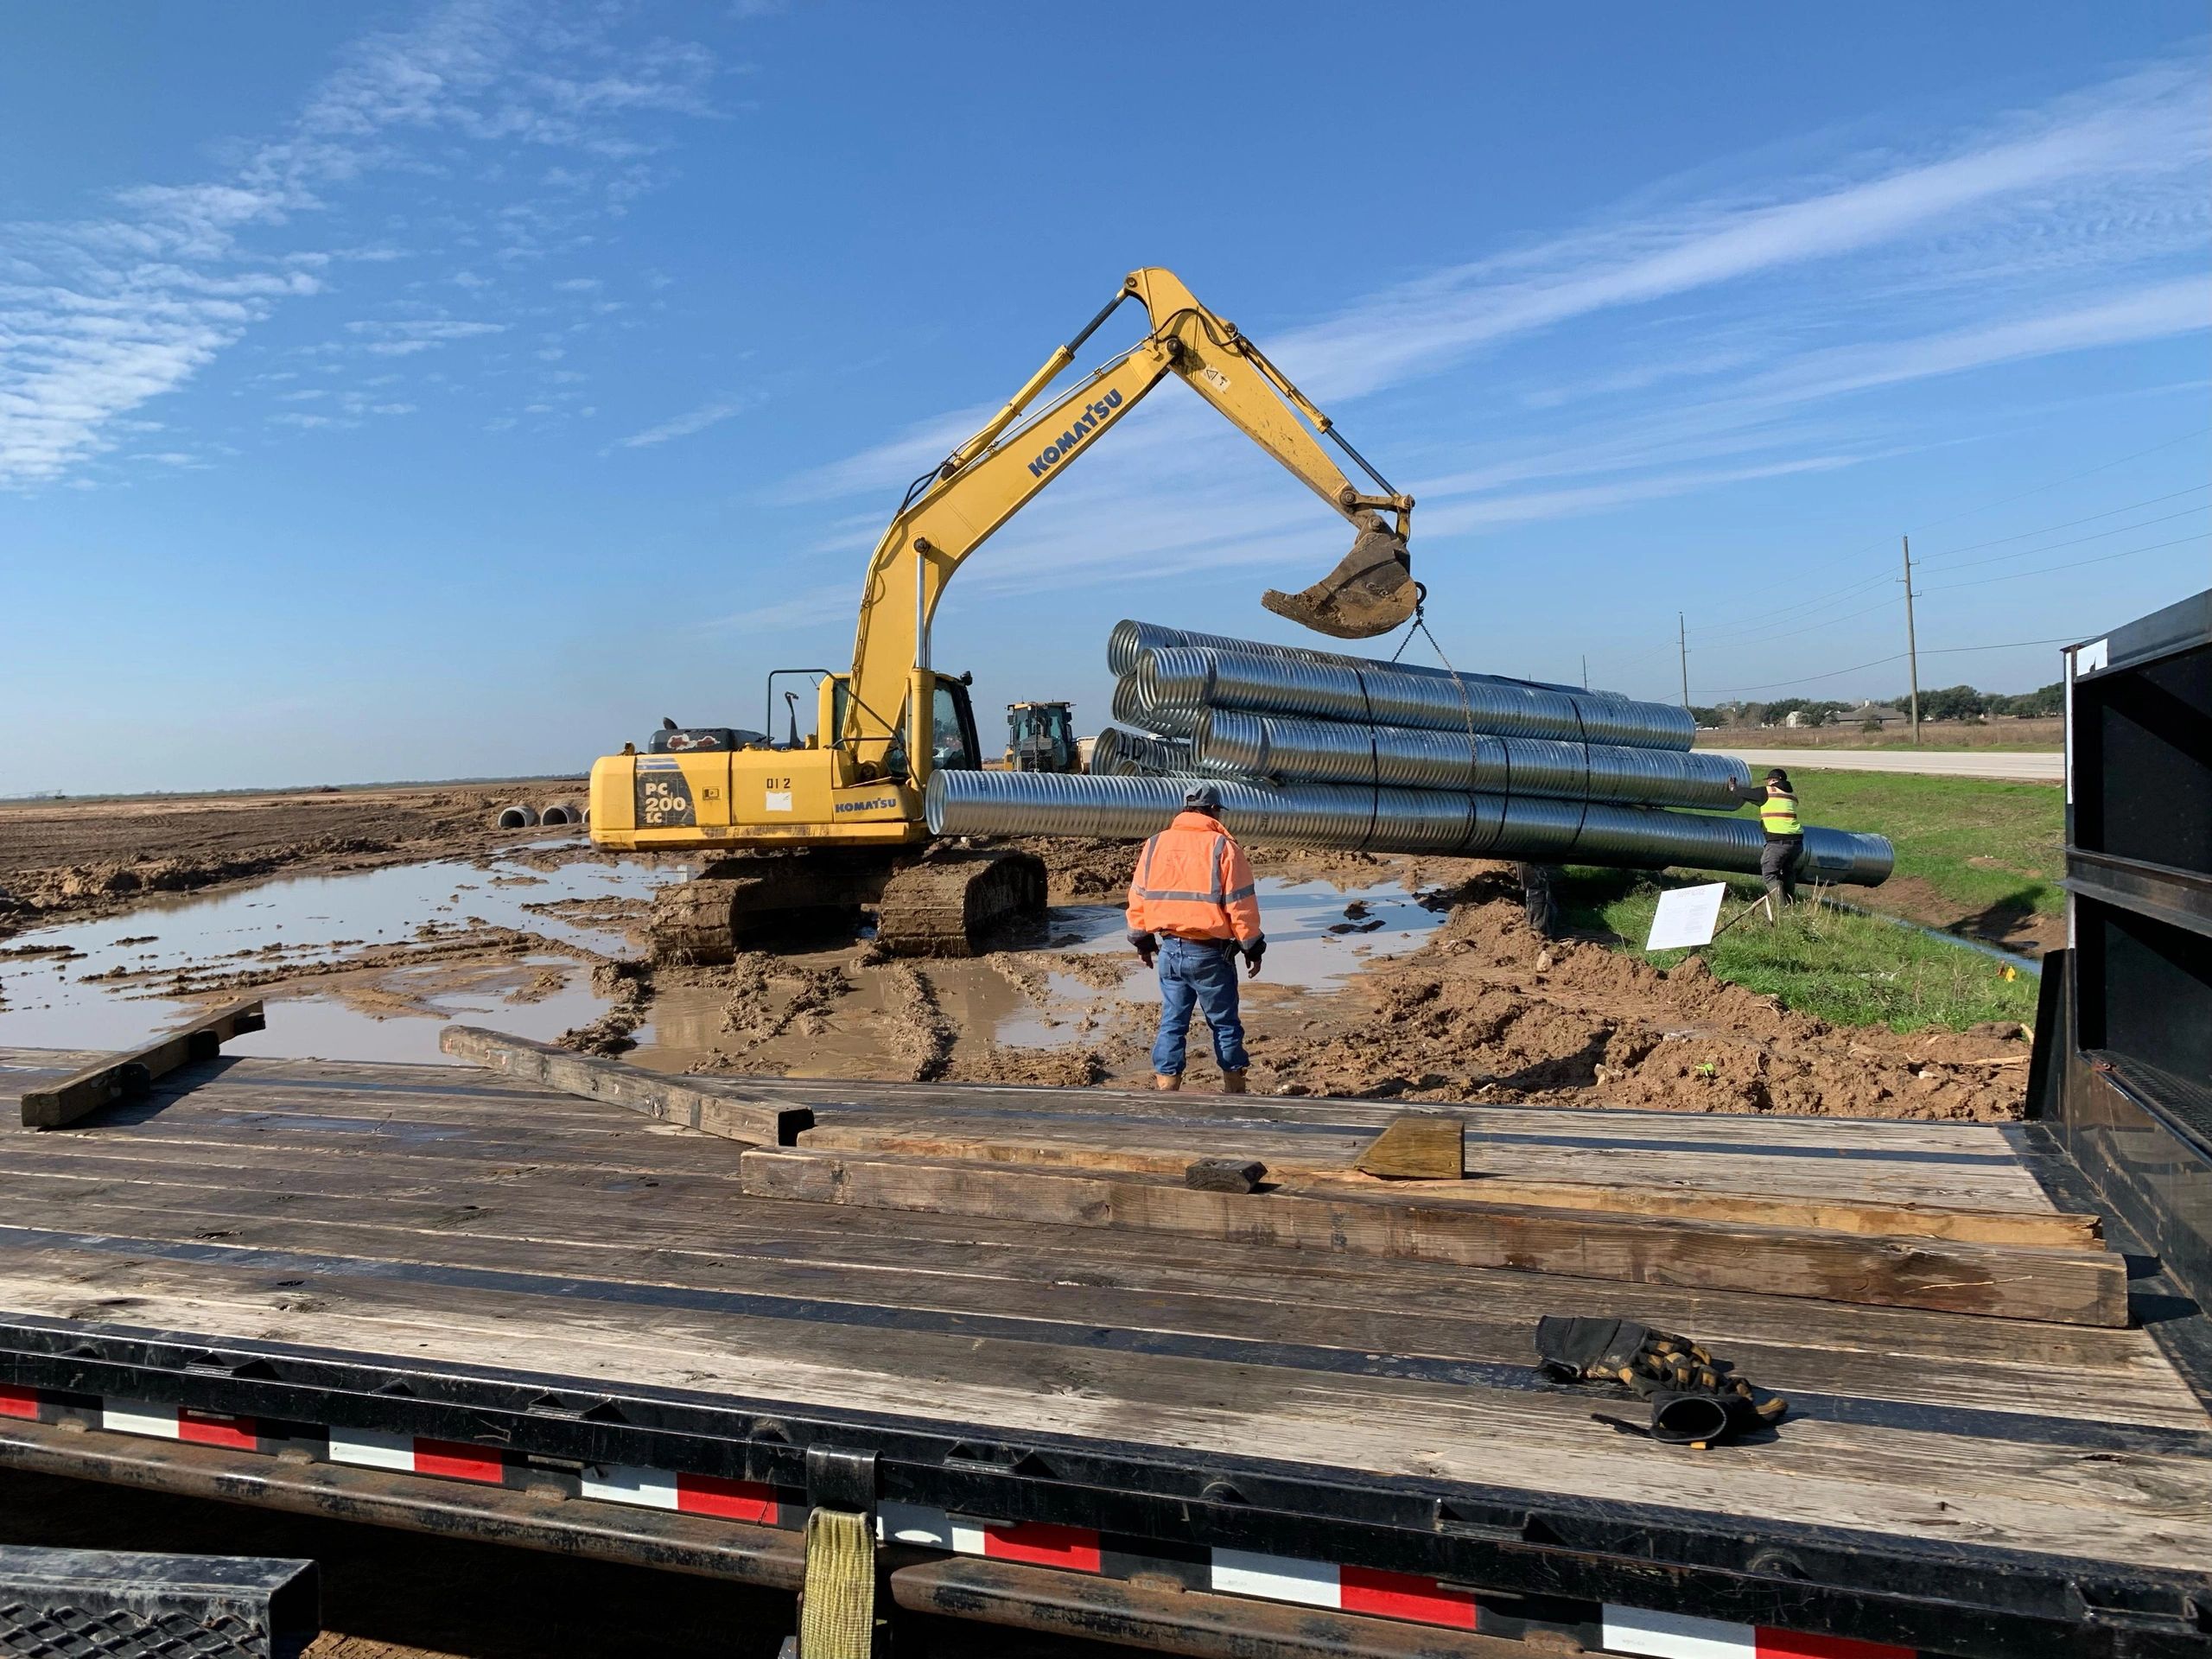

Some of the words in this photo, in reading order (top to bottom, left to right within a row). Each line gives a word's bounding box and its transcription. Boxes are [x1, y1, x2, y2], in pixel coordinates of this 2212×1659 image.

[1028, 389, 1122, 478] KOMATSU
[645, 782, 668, 795] PC
[645, 797, 686, 812] 200
[836, 798, 896, 813] KOMATSU
[645, 812, 663, 823] LC
